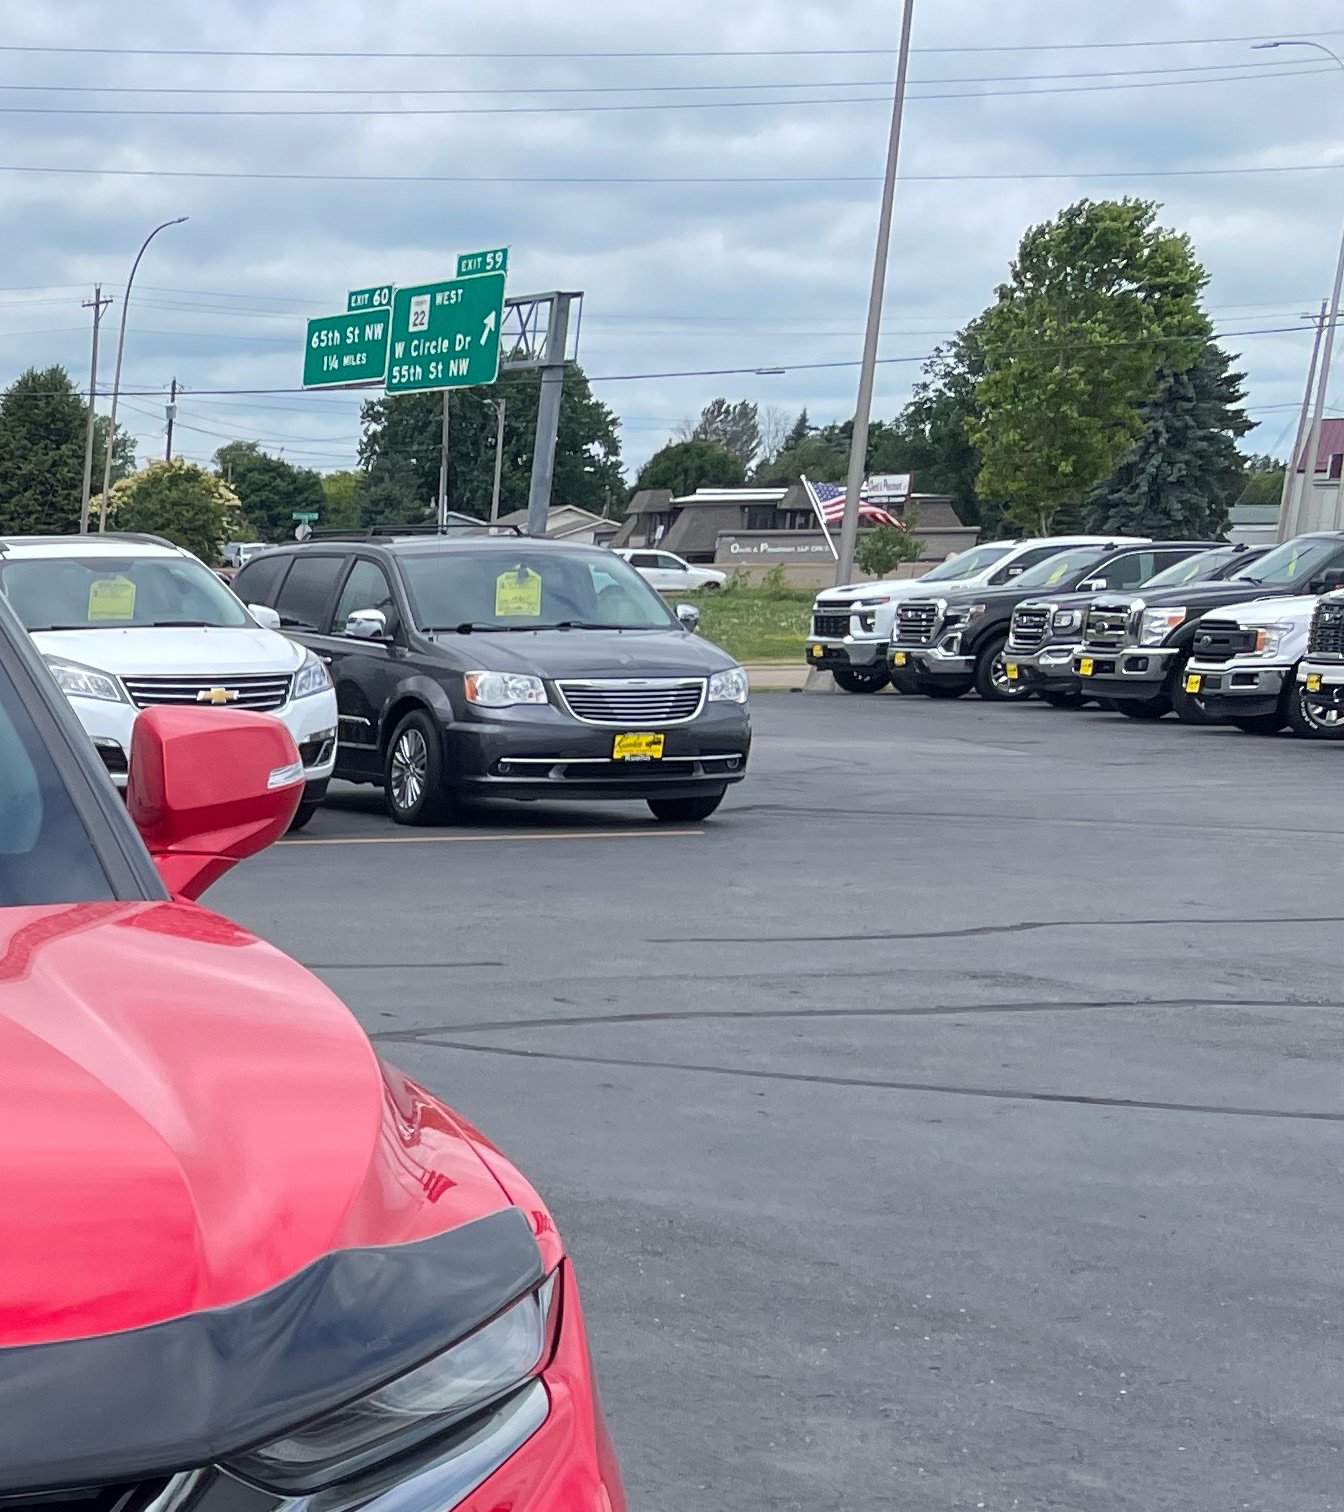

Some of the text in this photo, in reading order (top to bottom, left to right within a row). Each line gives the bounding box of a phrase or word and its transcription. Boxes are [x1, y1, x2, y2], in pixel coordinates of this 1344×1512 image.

[461, 251, 503, 272] EXIT 59
[350, 288, 389, 307] EXIT 60
[435, 289, 463, 306] WEST
[412, 310, 426, 327] 22
[311, 322, 384, 349] 65th St NW
[395, 333, 471, 359] W Circle Dr
[343, 352, 366, 367] MILES
[392, 357, 469, 384] 55th St NW
